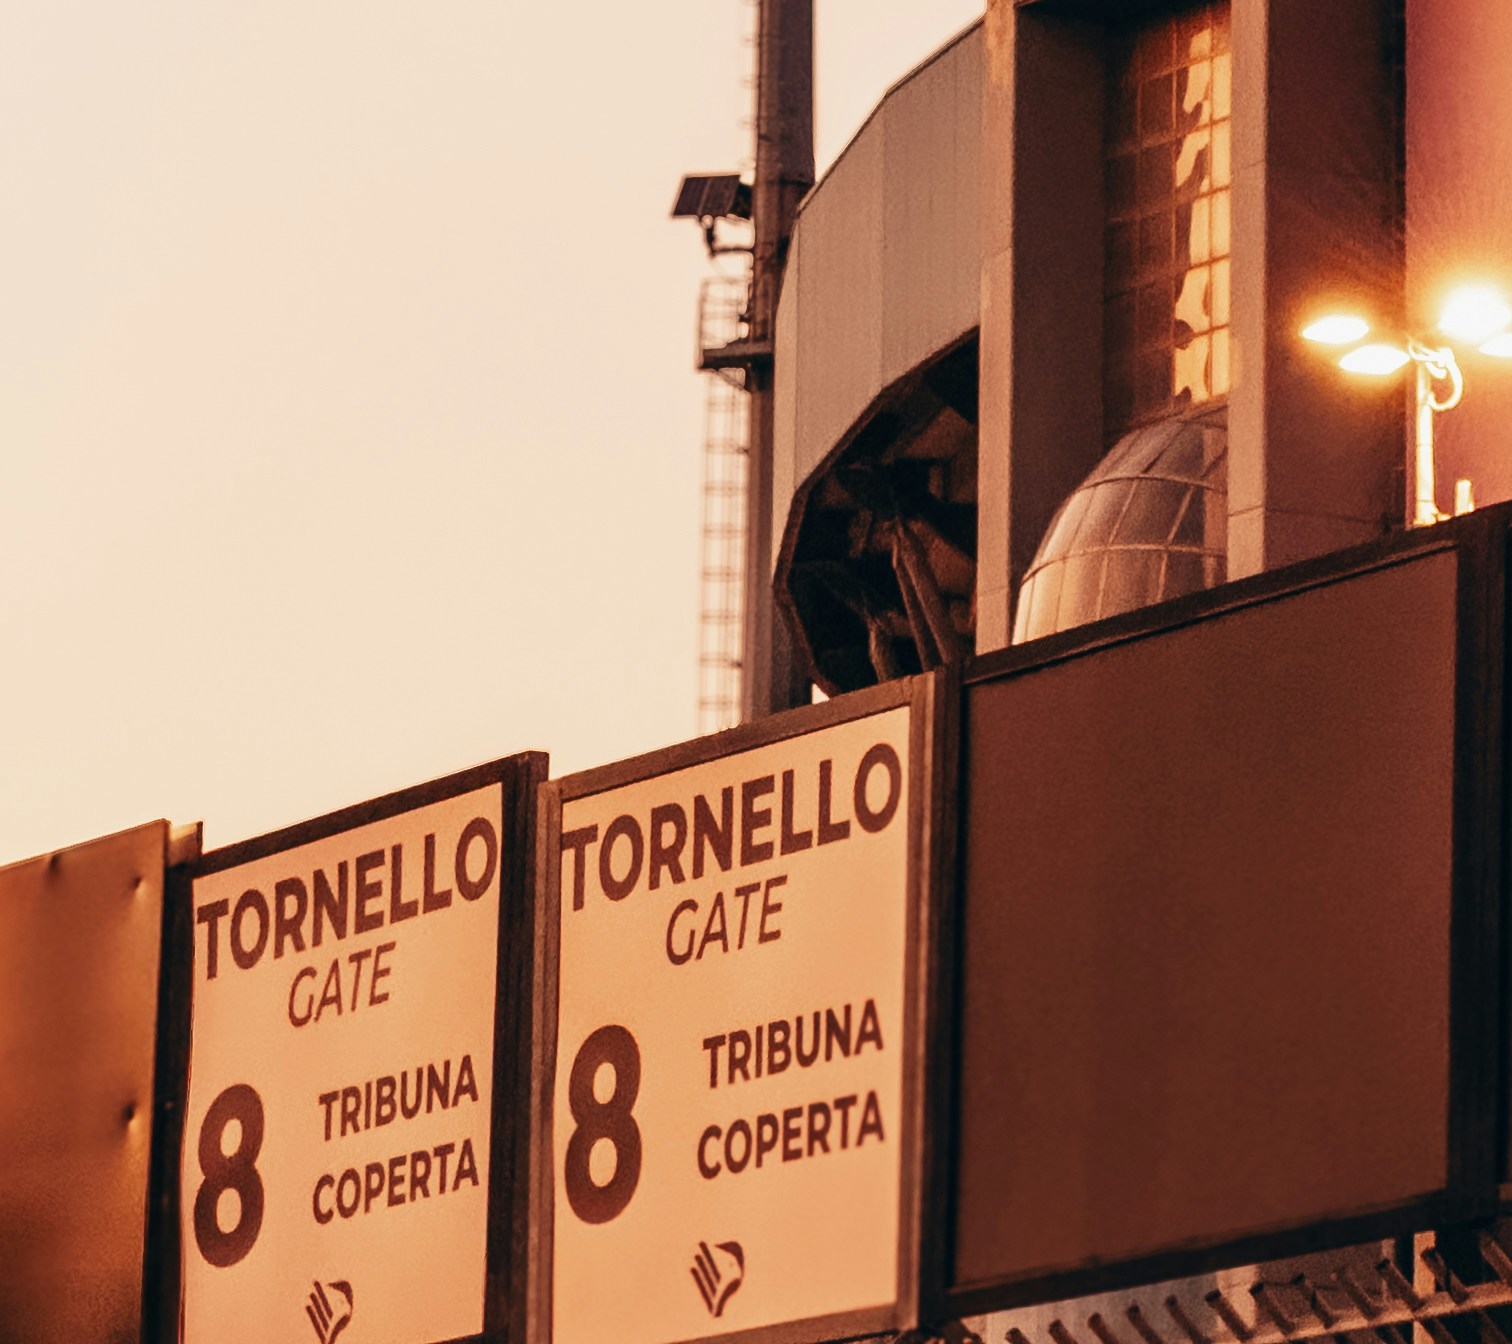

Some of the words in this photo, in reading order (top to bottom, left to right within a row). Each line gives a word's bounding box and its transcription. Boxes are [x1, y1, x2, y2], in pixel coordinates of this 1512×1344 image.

[561, 743, 902, 911] TORNELLO
[196, 817, 498, 980] TORNELLO
[665, 874, 788, 966] GATE
[288, 941, 397, 1028] GATE
[702, 998, 884, 1089] TRIBUNA
[319, 1053, 478, 1142] TRIBUNA
[564, 1024, 642, 1226] 8
[697, 1092, 885, 1181] COPERTA
[193, 1083, 265, 1268] 8
[312, 1138, 479, 1225] COPERTA
